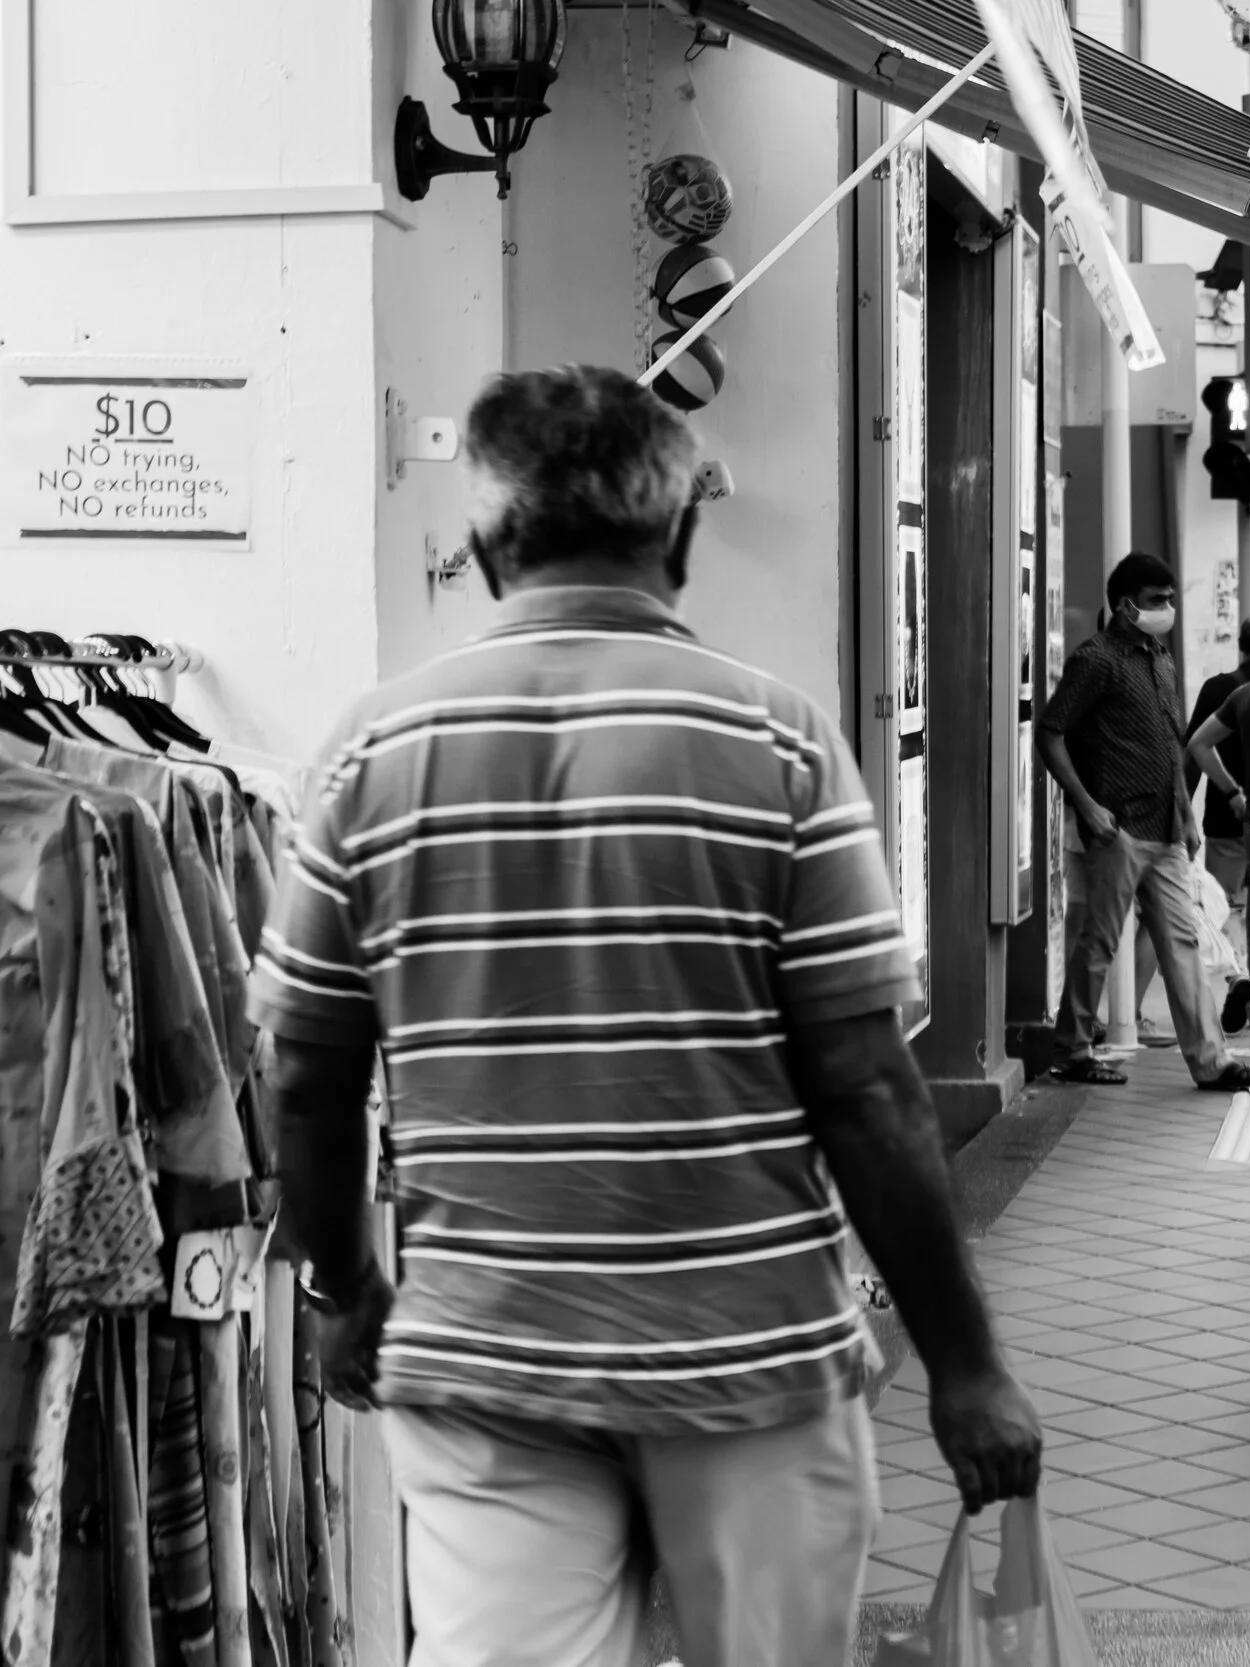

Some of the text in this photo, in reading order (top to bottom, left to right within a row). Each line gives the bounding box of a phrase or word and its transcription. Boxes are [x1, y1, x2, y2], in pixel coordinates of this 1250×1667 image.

[95, 392, 172, 438] $10
[67, 445, 200, 472] NO trying,
[39, 470, 229, 498] NO exchanges,
[60, 496, 208, 518] NO refunds
